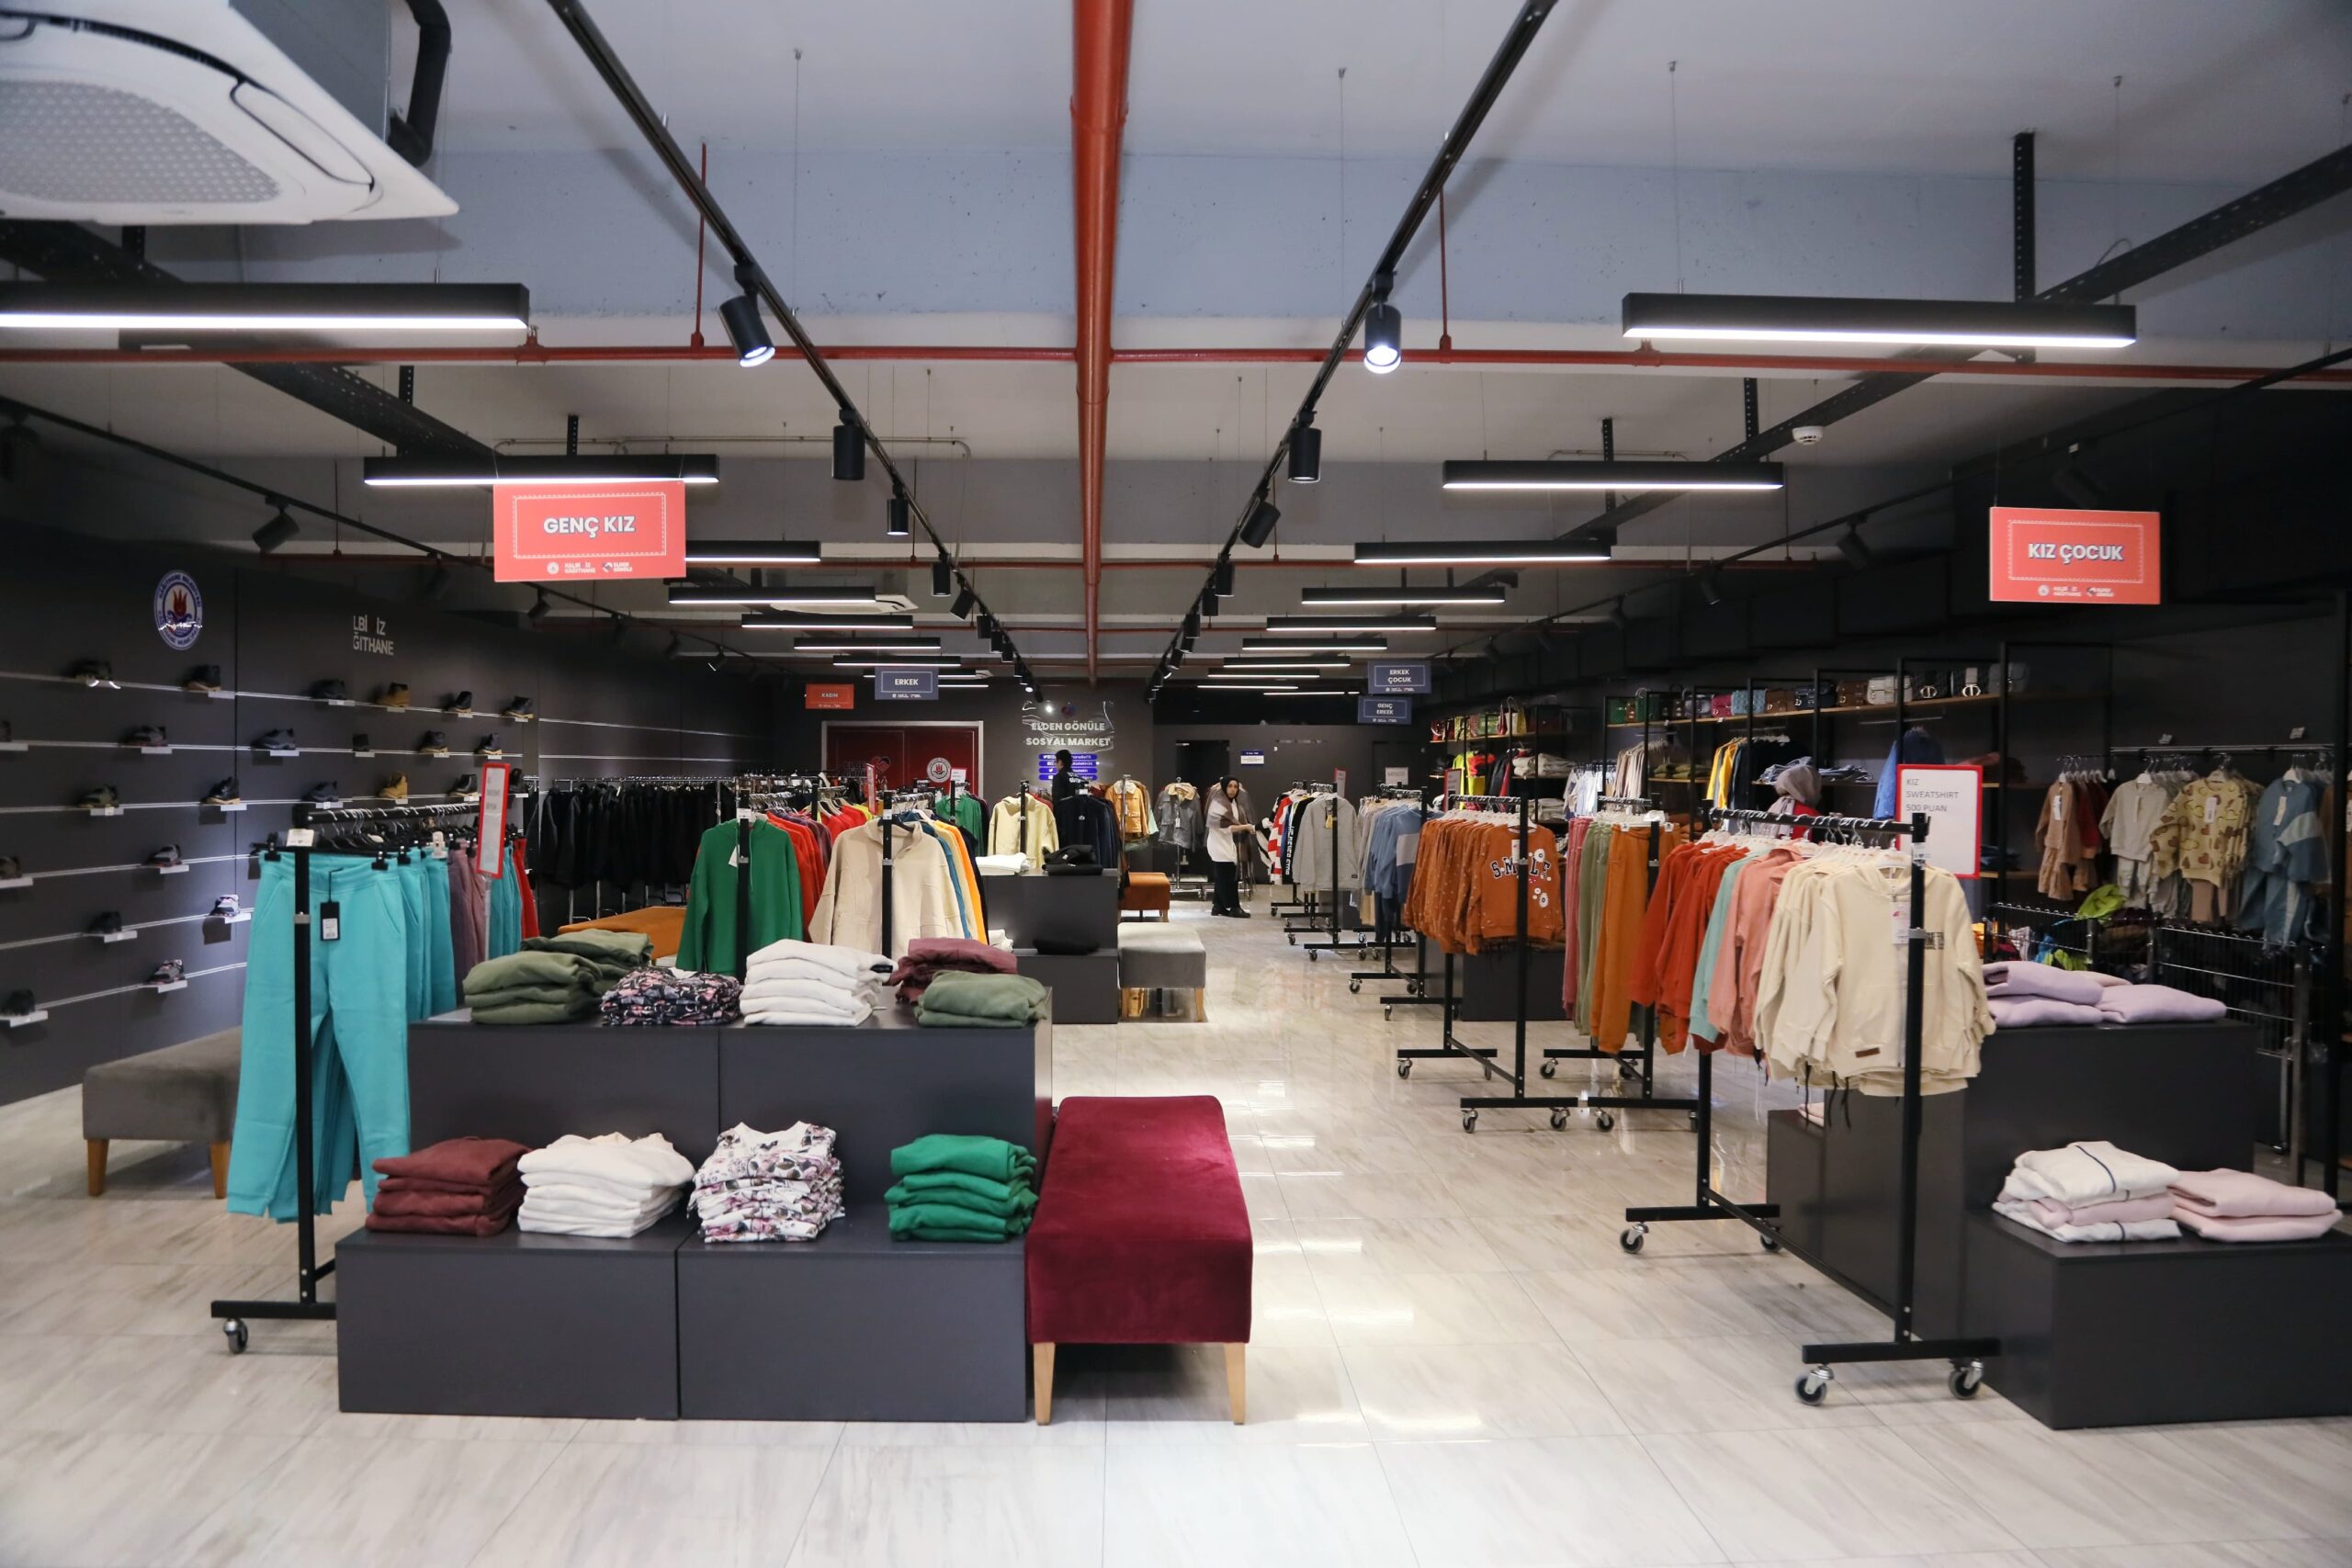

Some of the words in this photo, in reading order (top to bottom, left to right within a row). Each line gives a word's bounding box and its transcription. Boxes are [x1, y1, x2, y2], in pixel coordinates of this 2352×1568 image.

[543, 516, 599, 538] GENÇ
[604, 515, 636, 533] KIZ
[2028, 543, 2056, 558] KIZ
[2059, 544, 2124, 564] ÇOCUK
[894, 678, 919, 686] ERKEK
[1387, 676, 1412, 684] ÇOCUK
[1031, 722, 1063, 731] ELDEN
[1064, 720, 1105, 731] GÖNÜLE
[1025, 738, 1066, 746] SOSYAL
[1068, 738, 1111, 746] MARKET
[1906, 778, 1919, 786] KIZ
[1905, 791, 1960, 799] SWEATSHIRT
[1905, 804, 1922, 812] 500
